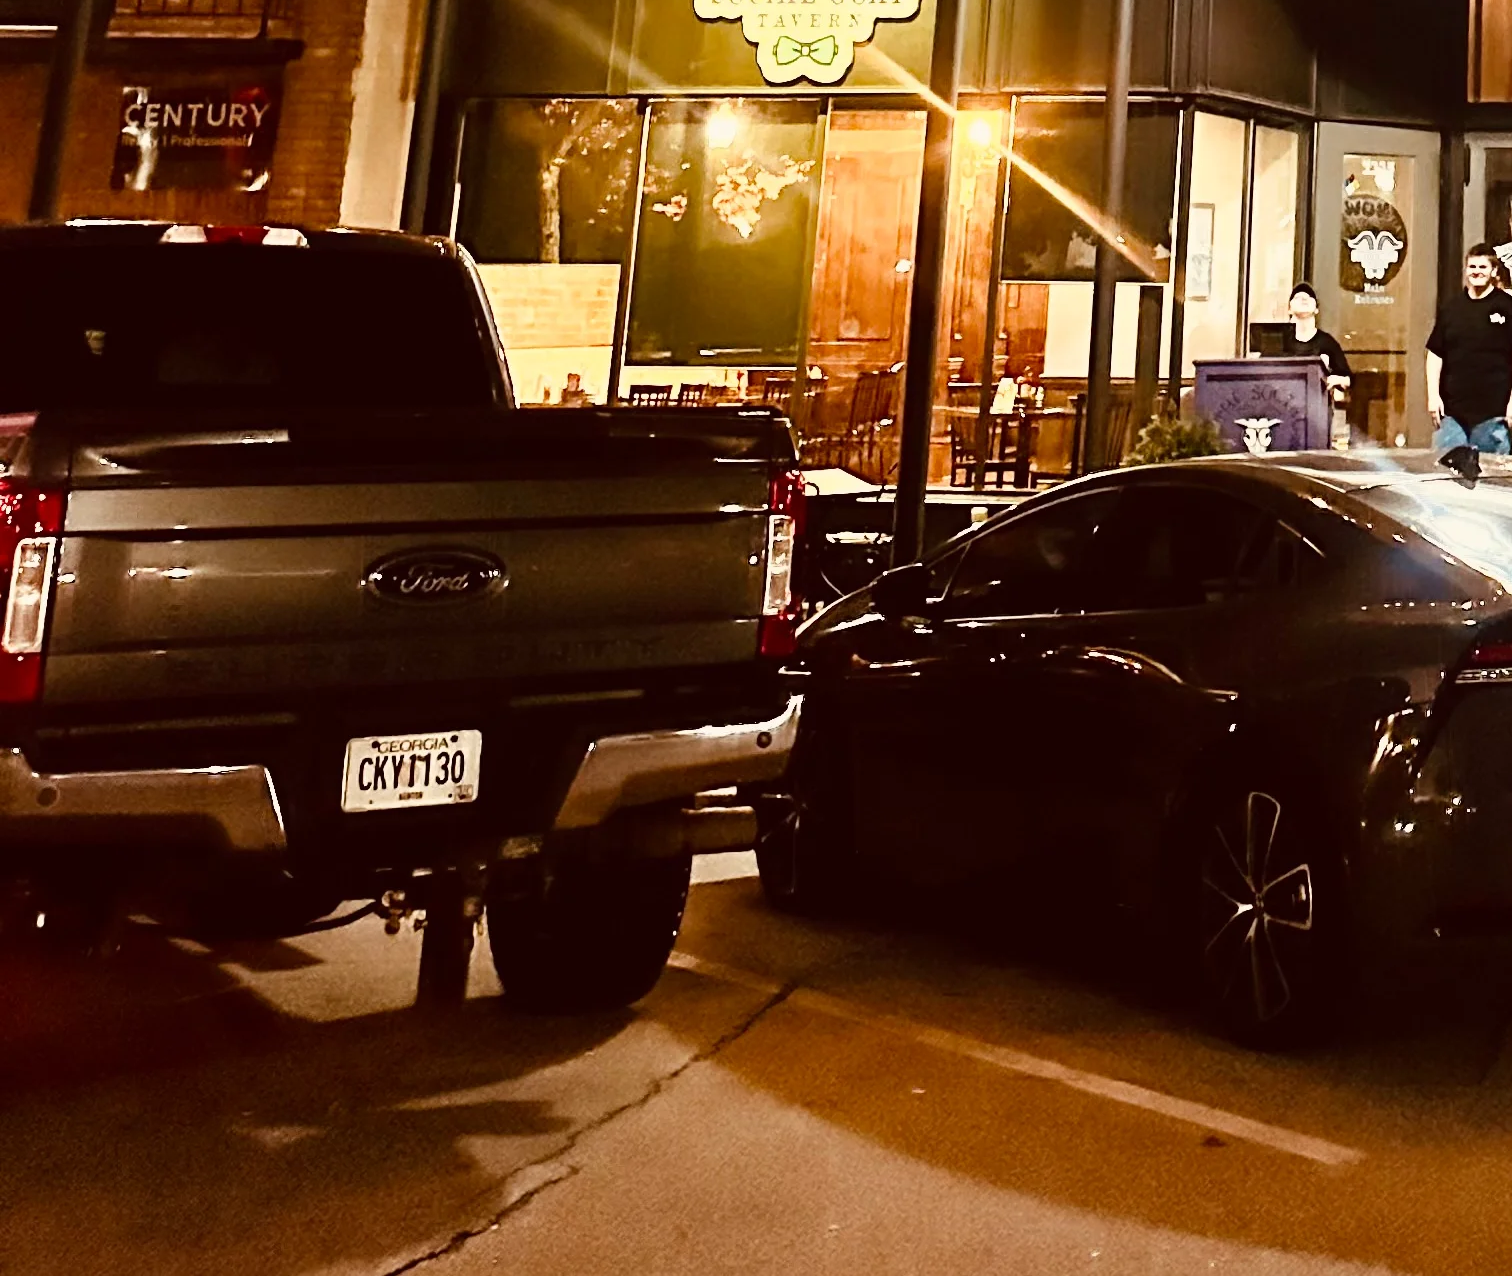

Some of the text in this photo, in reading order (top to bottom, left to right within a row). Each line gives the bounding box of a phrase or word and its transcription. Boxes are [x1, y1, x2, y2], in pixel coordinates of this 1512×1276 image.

[757, 13, 862, 28] TAVERN
[124, 102, 271, 128] CENTURY
[400, 563, 471, 593] Ford
[377, 737, 449, 754] GEORGIA
[358, 750, 465, 791] CKY1130
